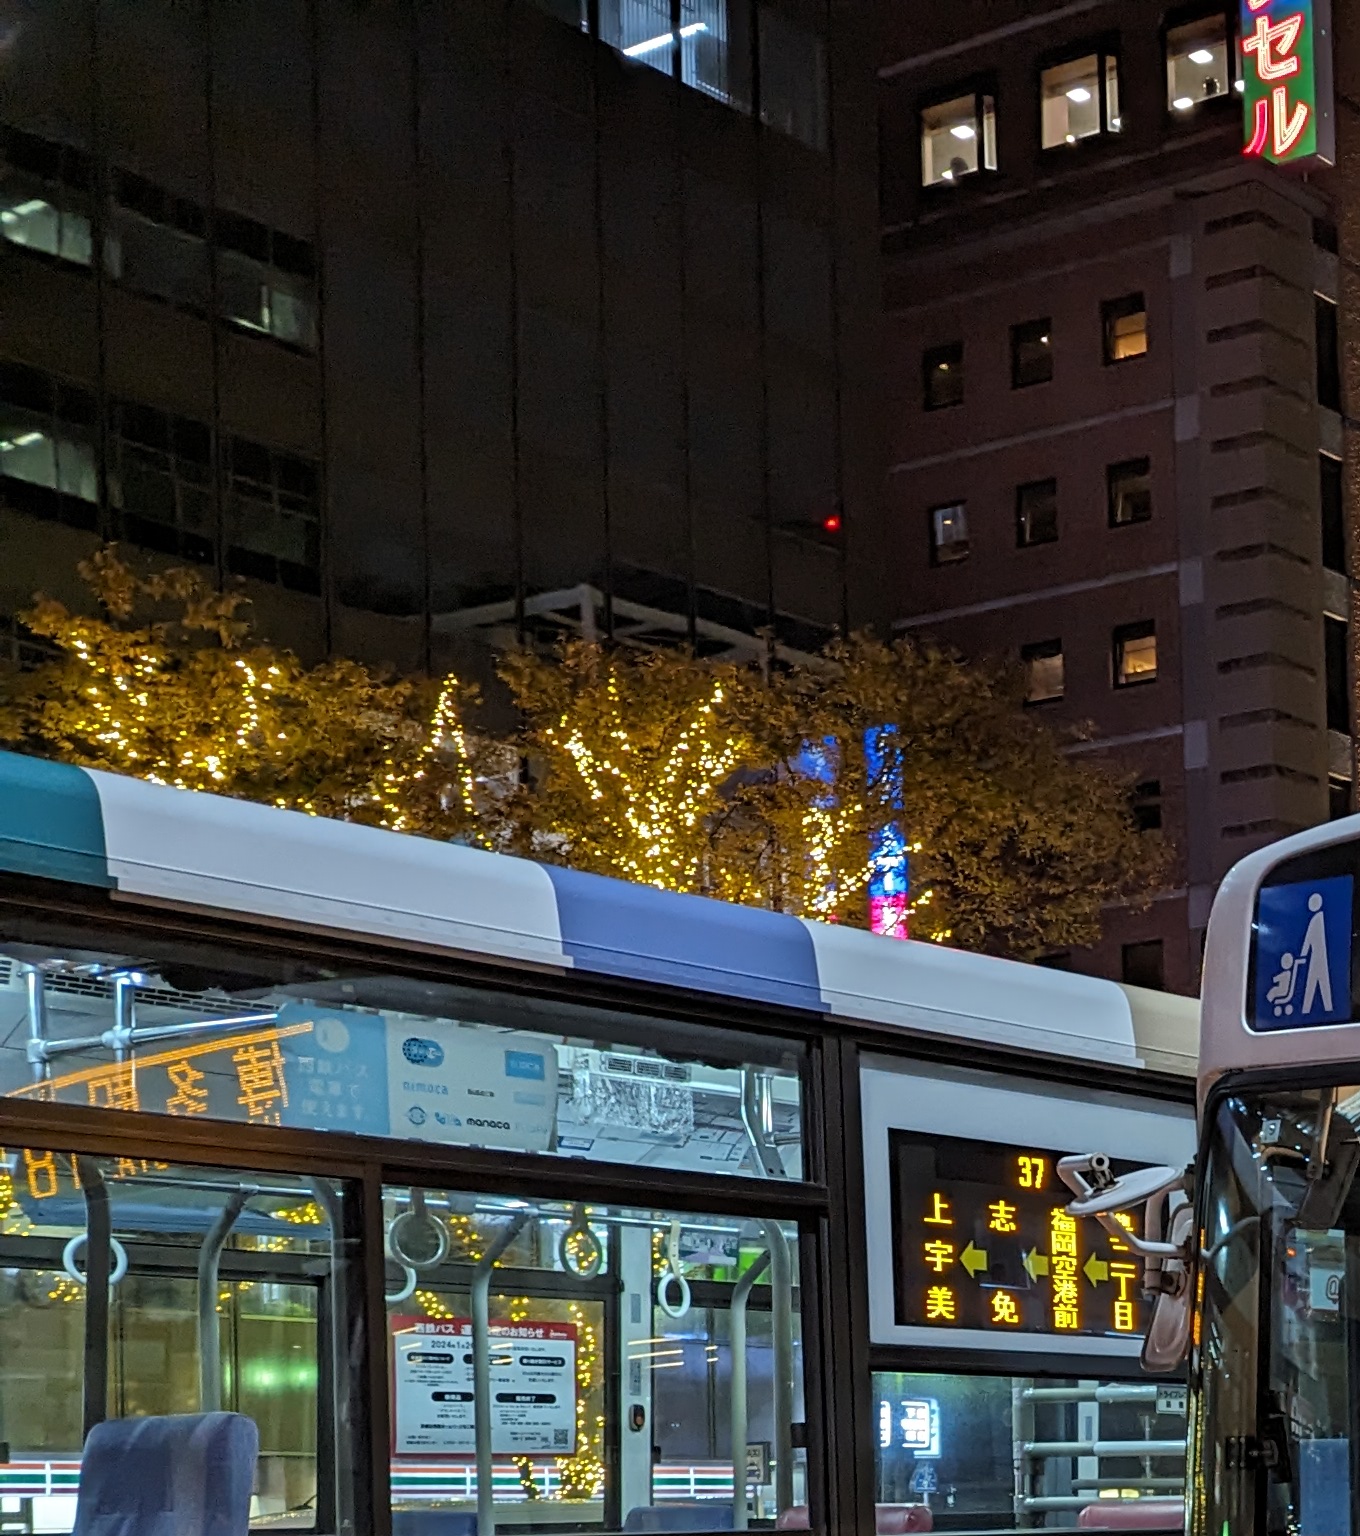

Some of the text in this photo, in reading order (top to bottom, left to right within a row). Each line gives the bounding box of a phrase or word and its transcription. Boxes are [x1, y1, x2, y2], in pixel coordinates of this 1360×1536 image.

[1243, 0, 1308, 156] セル
[466, 1117, 511, 1130] manaca
[1018, 1156, 1045, 1189] 37
[923, 1194, 956, 1320] 上宇美
[987, 1200, 1019, 1324] 志免
[1050, 1208, 1079, 1330] 福岡空港前
